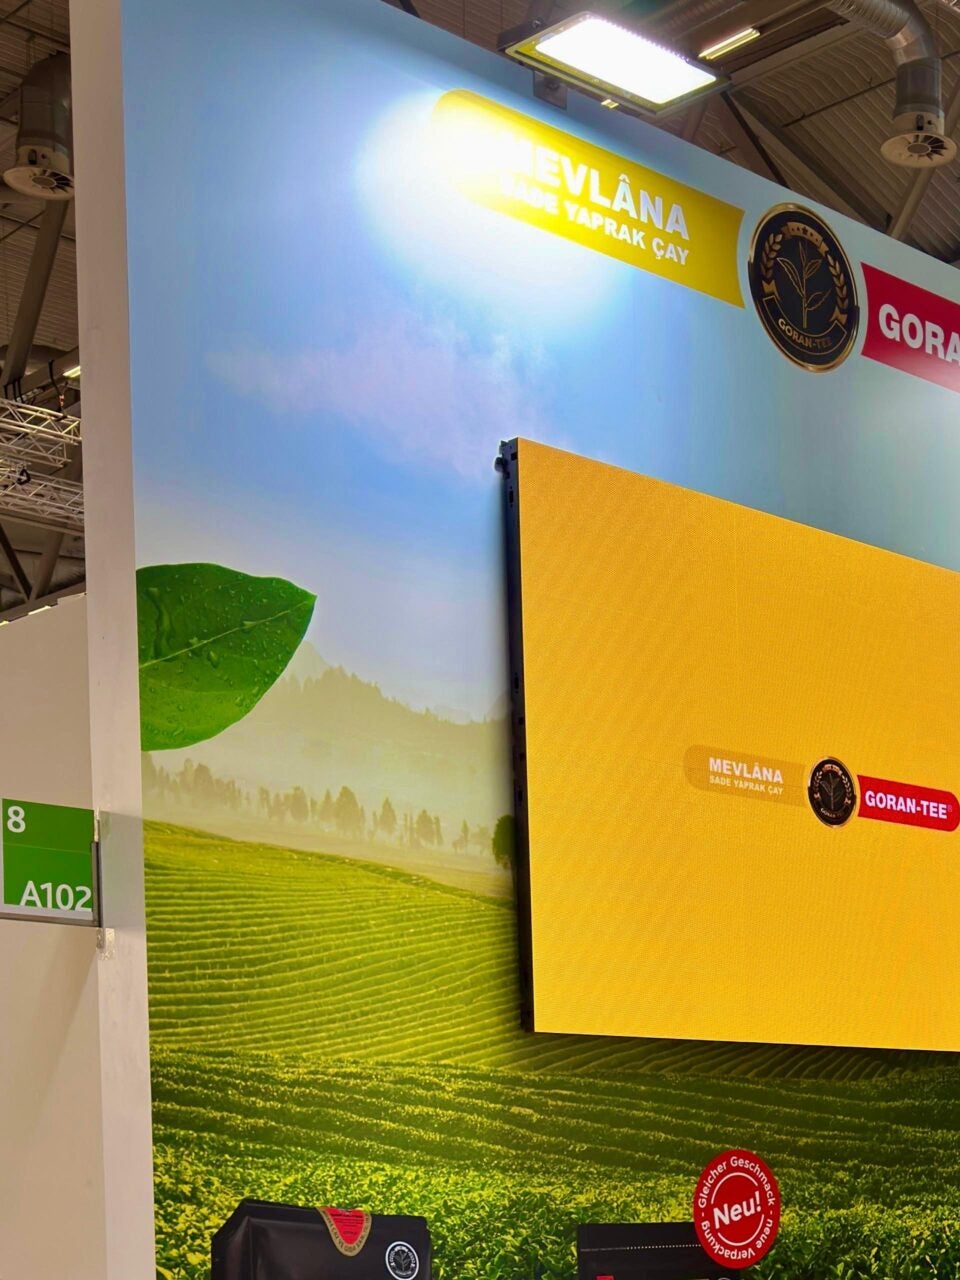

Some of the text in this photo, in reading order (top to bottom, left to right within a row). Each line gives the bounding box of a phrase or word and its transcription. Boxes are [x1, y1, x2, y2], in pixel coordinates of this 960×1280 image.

[564, 201, 646, 249] YAPRAK
[652, 237, 689, 265] ÇAY
[778, 318, 832, 349] GORAN-TEE
[709, 757, 784, 784] MEVLÂNA
[709, 775, 784, 796] SADE YAPRAK ÇAY
[7, 805, 26, 833] 8
[20, 880, 92, 912] A102
[698, 1156, 775, 1208] Gleicher Geschmack
[713, 1191, 761, 1229] Neu!
[701, 1219, 774, 1260] neue Verpackung
